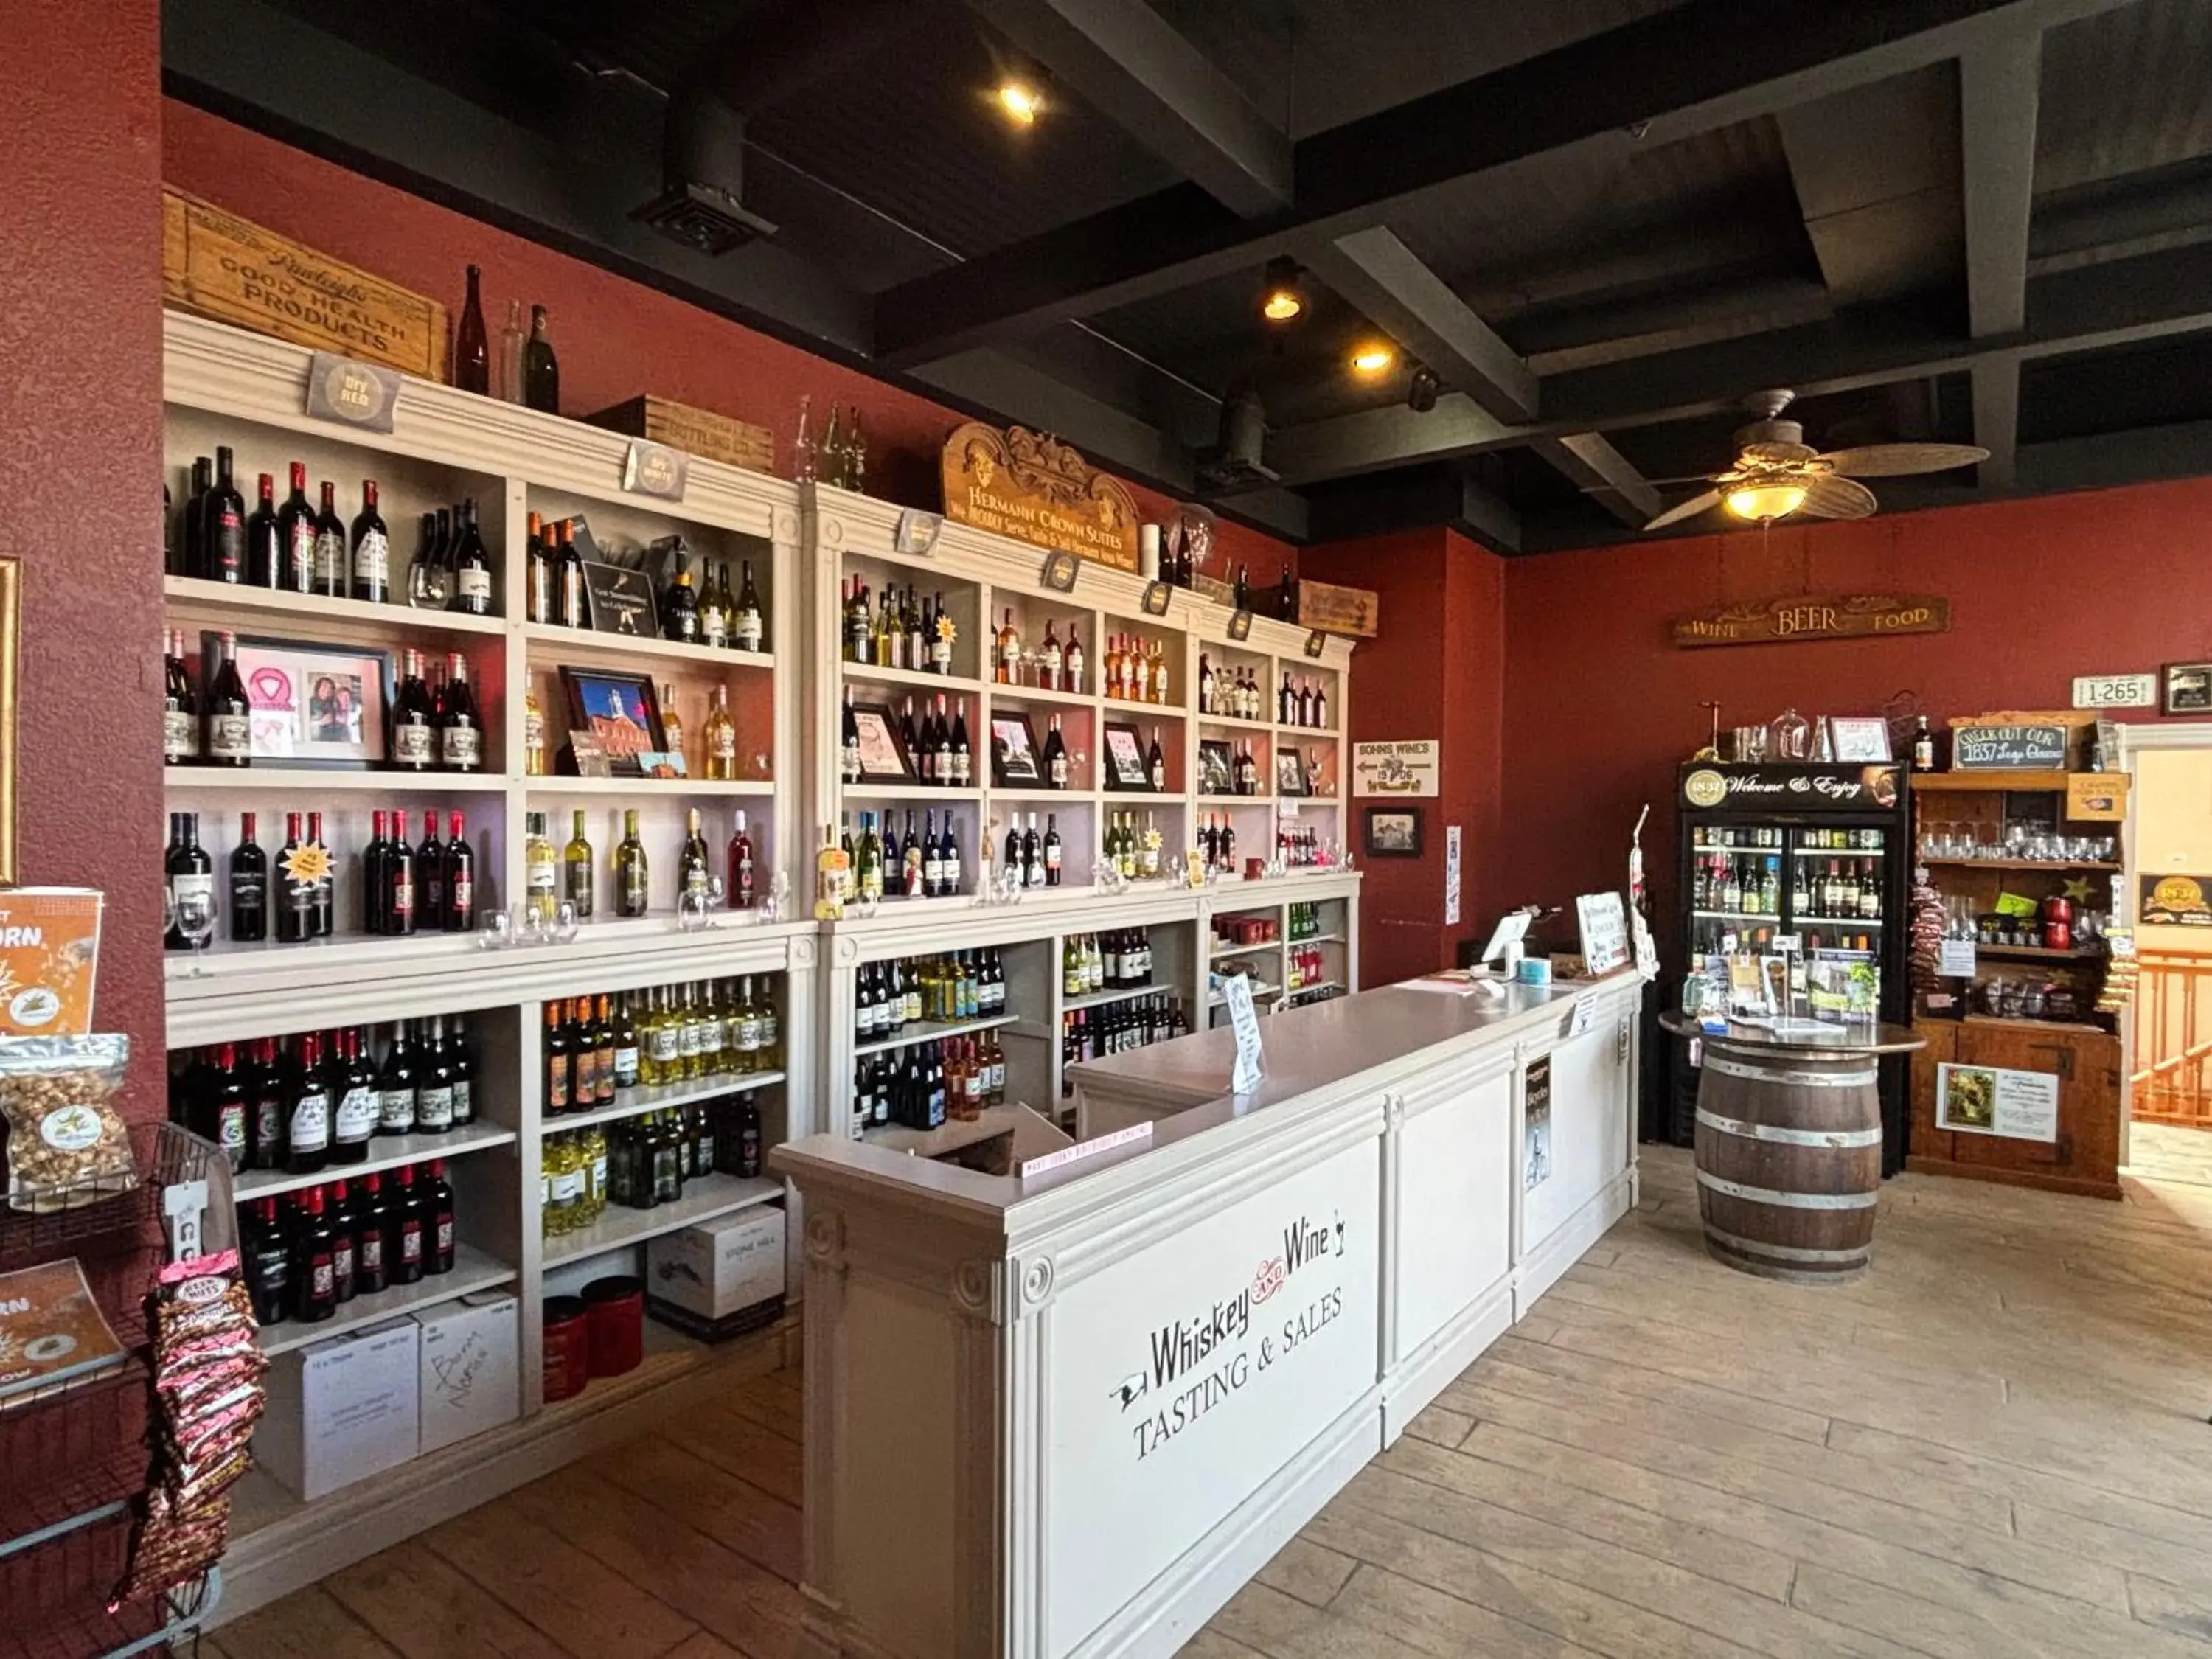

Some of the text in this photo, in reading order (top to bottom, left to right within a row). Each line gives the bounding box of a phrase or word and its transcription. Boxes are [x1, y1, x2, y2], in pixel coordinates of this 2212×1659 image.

[220, 257, 406, 340] GOOD HEALTH
[243, 282, 388, 352] PRODUCTS
[341, 388, 369, 405] RED
[968, 486, 1122, 550] HERMANN CROWN SUITES
[1778, 607, 1839, 635] BEER
[1874, 608, 1929, 630] FOOD
[1396, 742, 1430, 755] WINES
[1960, 727, 2055, 746] CHECK OUT OUR
[1963, 742, 1997, 762] 1837
[1724, 773, 1785, 794] Welcome
[1812, 776, 1863, 799] Enjoy
[1150, 1288, 1249, 1389] Whiskey
[1284, 1215, 1329, 1276] Wine
[1133, 1286, 1343, 1461] TASTING & SALES
